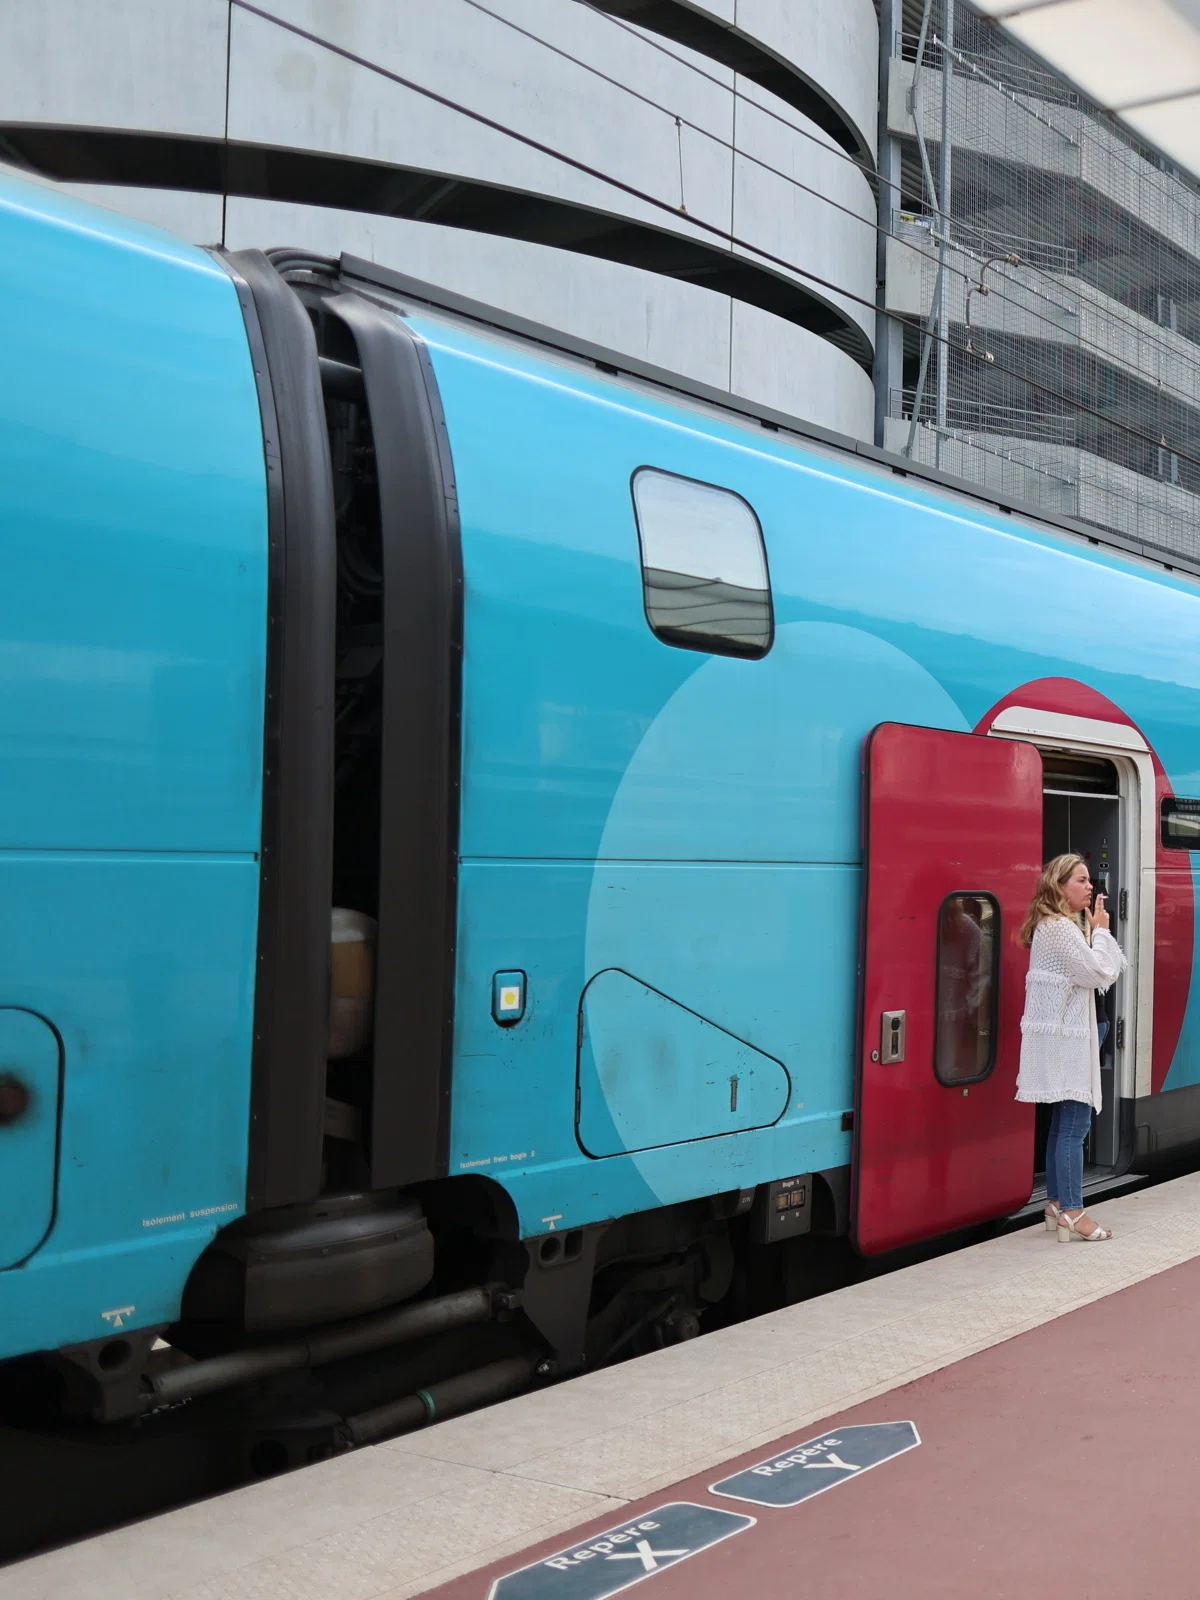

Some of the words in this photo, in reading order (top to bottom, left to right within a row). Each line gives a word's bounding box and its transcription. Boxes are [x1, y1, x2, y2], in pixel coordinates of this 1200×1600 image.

[460, 1158, 491, 1168] Isolement
[142, 1212, 185, 1227] Isolement
[190, 1203, 238, 1218] suspension
[752, 1437, 842, 1476] Repère
[802, 1453, 862, 1472] Y
[544, 1519, 661, 1571] Repère
[605, 1540, 690, 1571] X
